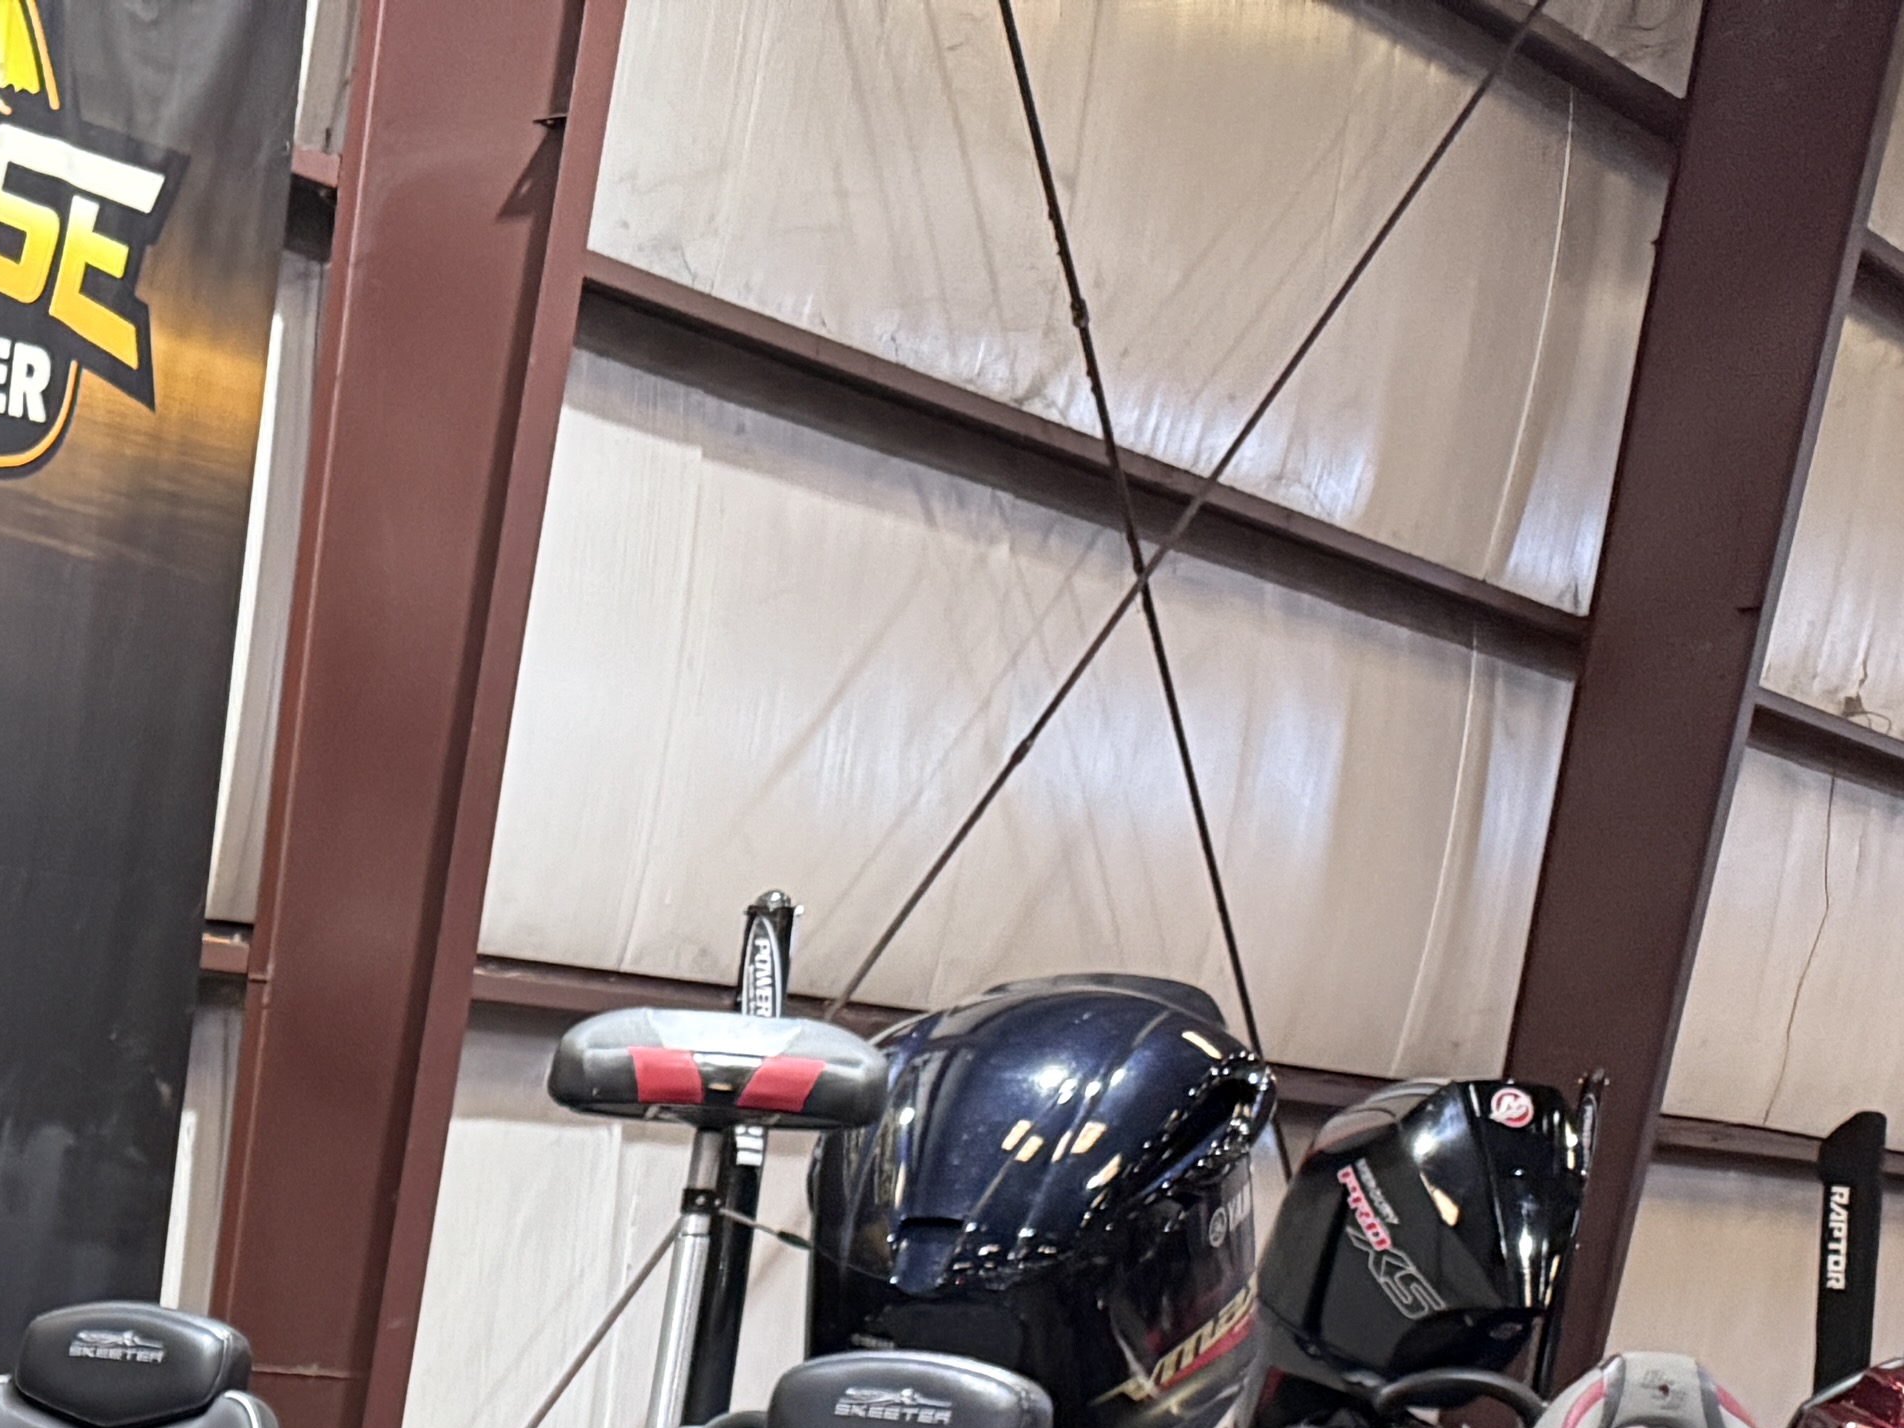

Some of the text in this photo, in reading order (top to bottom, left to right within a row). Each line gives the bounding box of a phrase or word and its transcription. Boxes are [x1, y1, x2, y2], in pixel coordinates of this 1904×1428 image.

[754, 938, 773, 1018] POWER
[1826, 1185, 1851, 1290] RAPTOR
[833, 1402, 953, 1425] SKEETER
